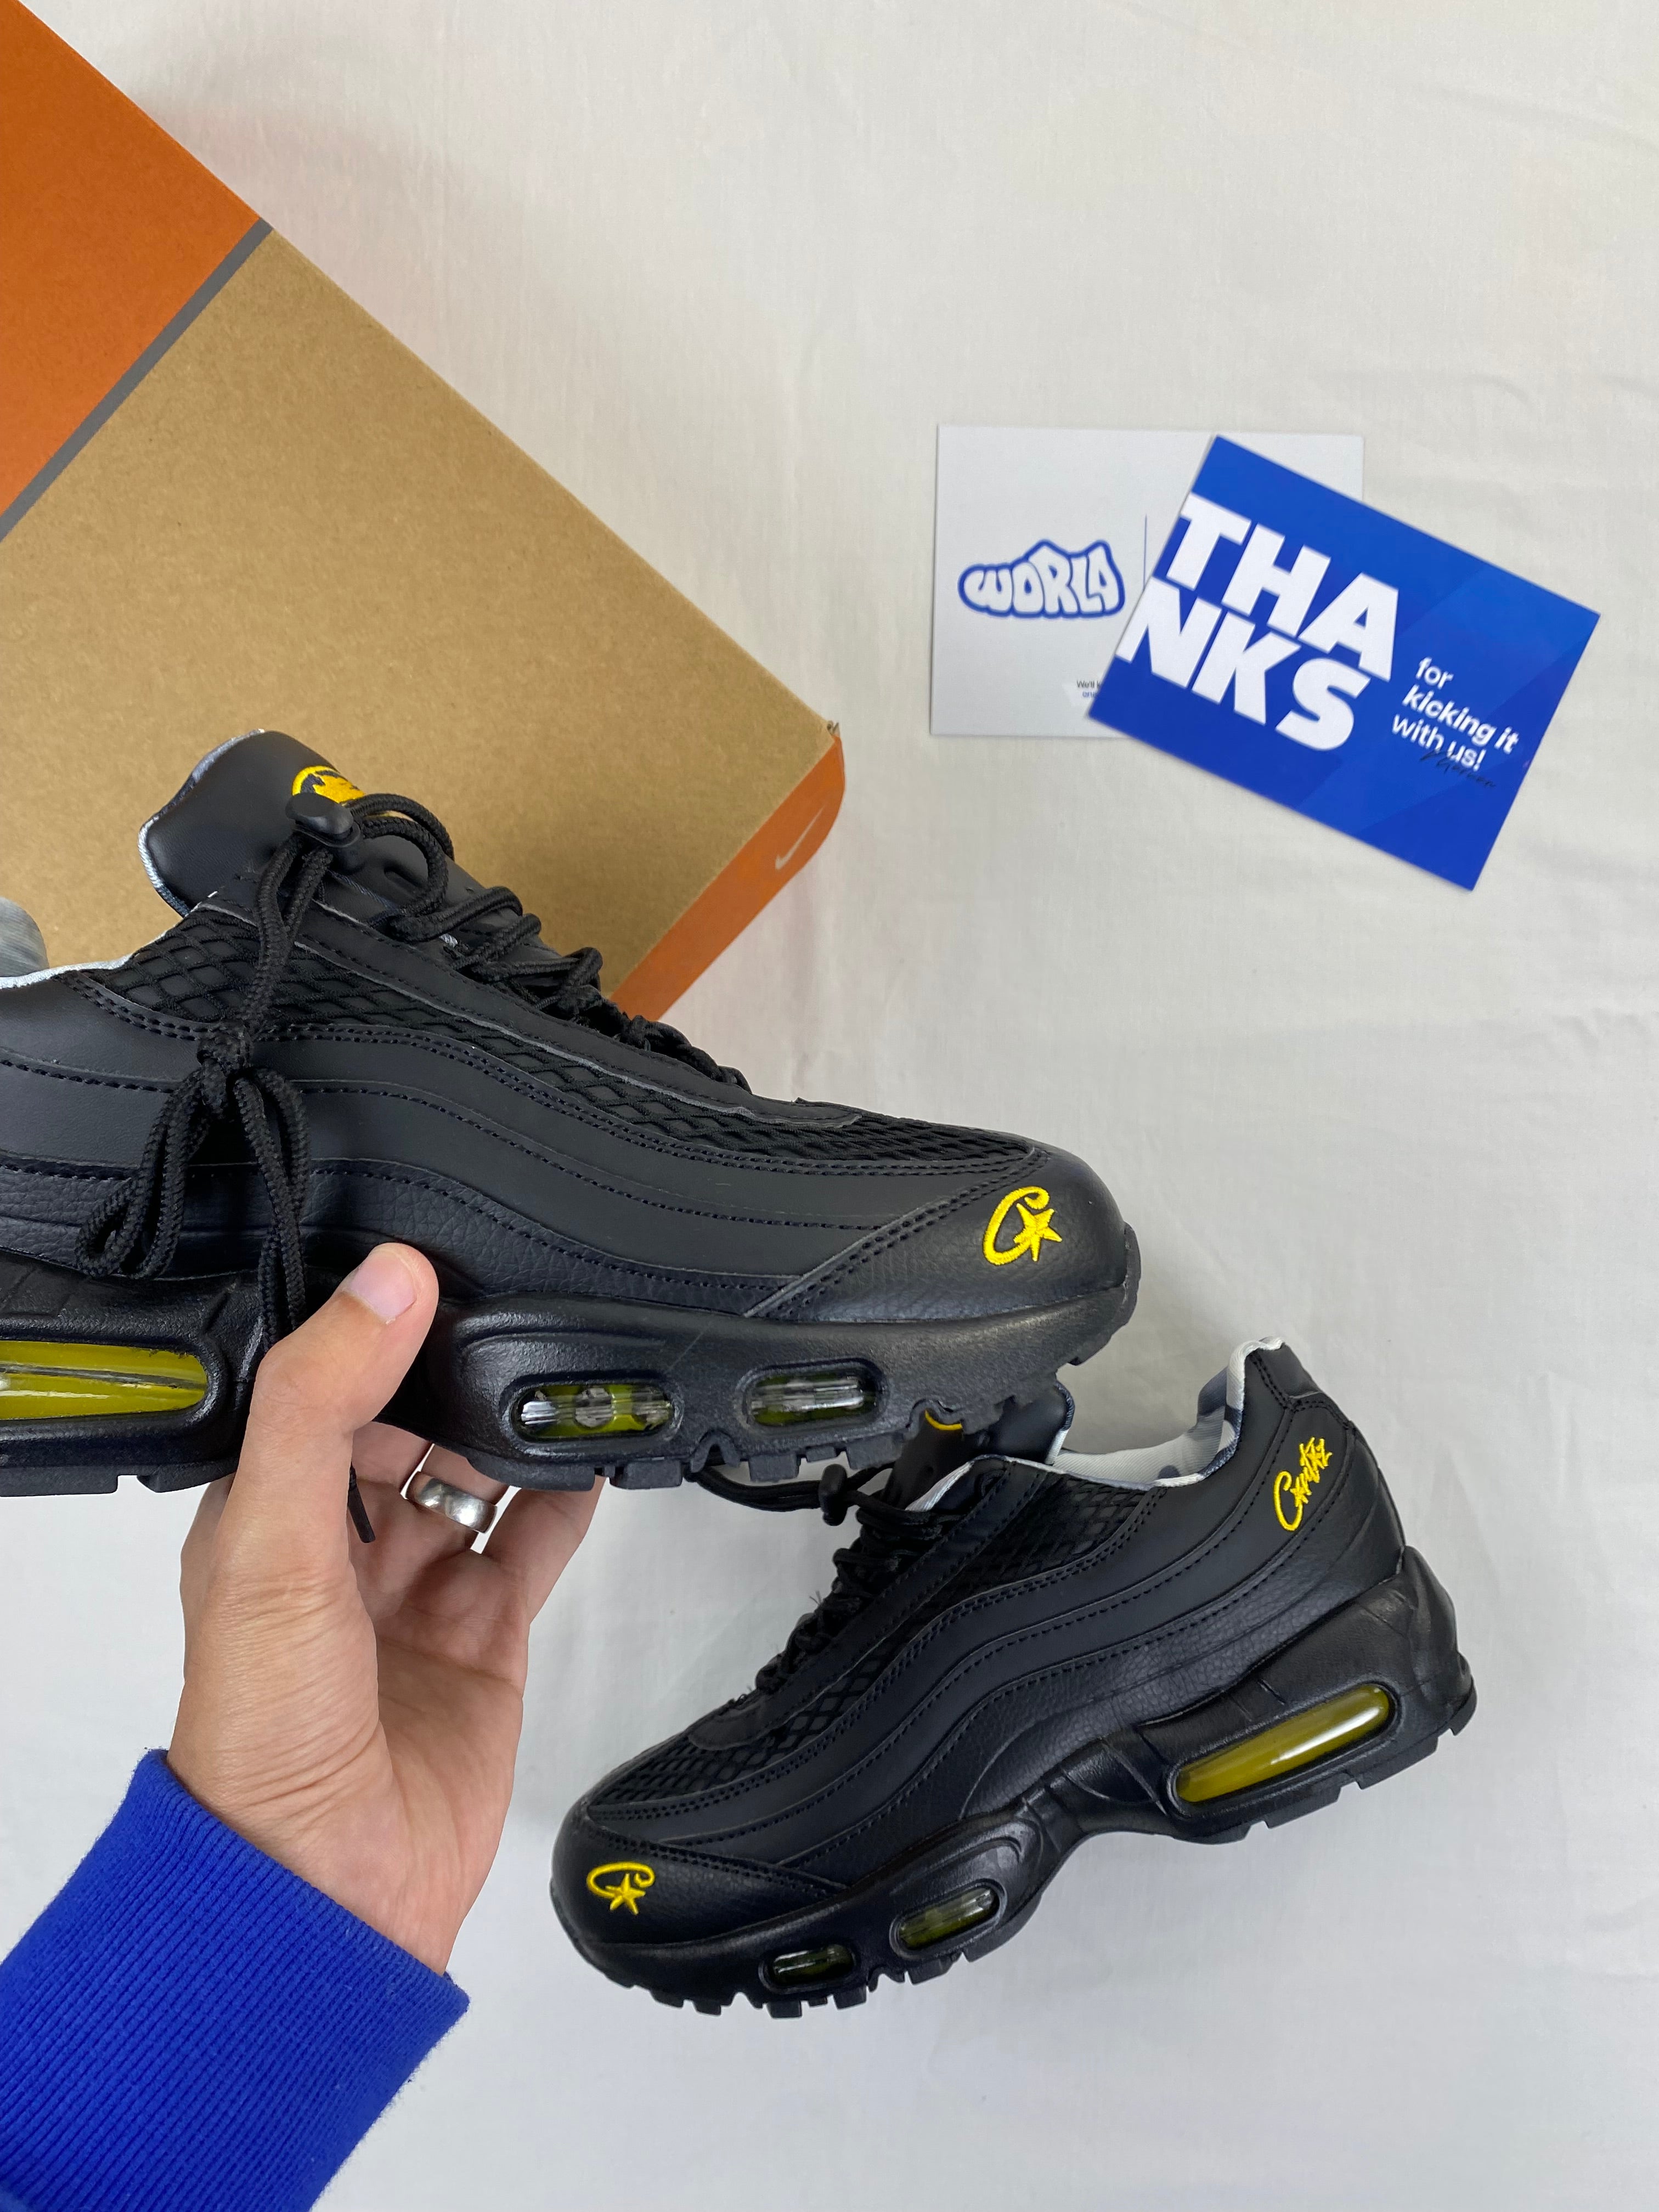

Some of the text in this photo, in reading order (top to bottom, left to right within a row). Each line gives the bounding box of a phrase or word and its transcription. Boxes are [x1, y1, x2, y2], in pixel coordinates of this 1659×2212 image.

[1180, 492, 1398, 681] THA
[1114, 575, 1371, 751] NKS
[1415, 657, 1454, 689] for
[1392, 714, 1444, 754] with
[1447, 741, 1487, 771] us!
[1402, 684, 1519, 754] kicking it
